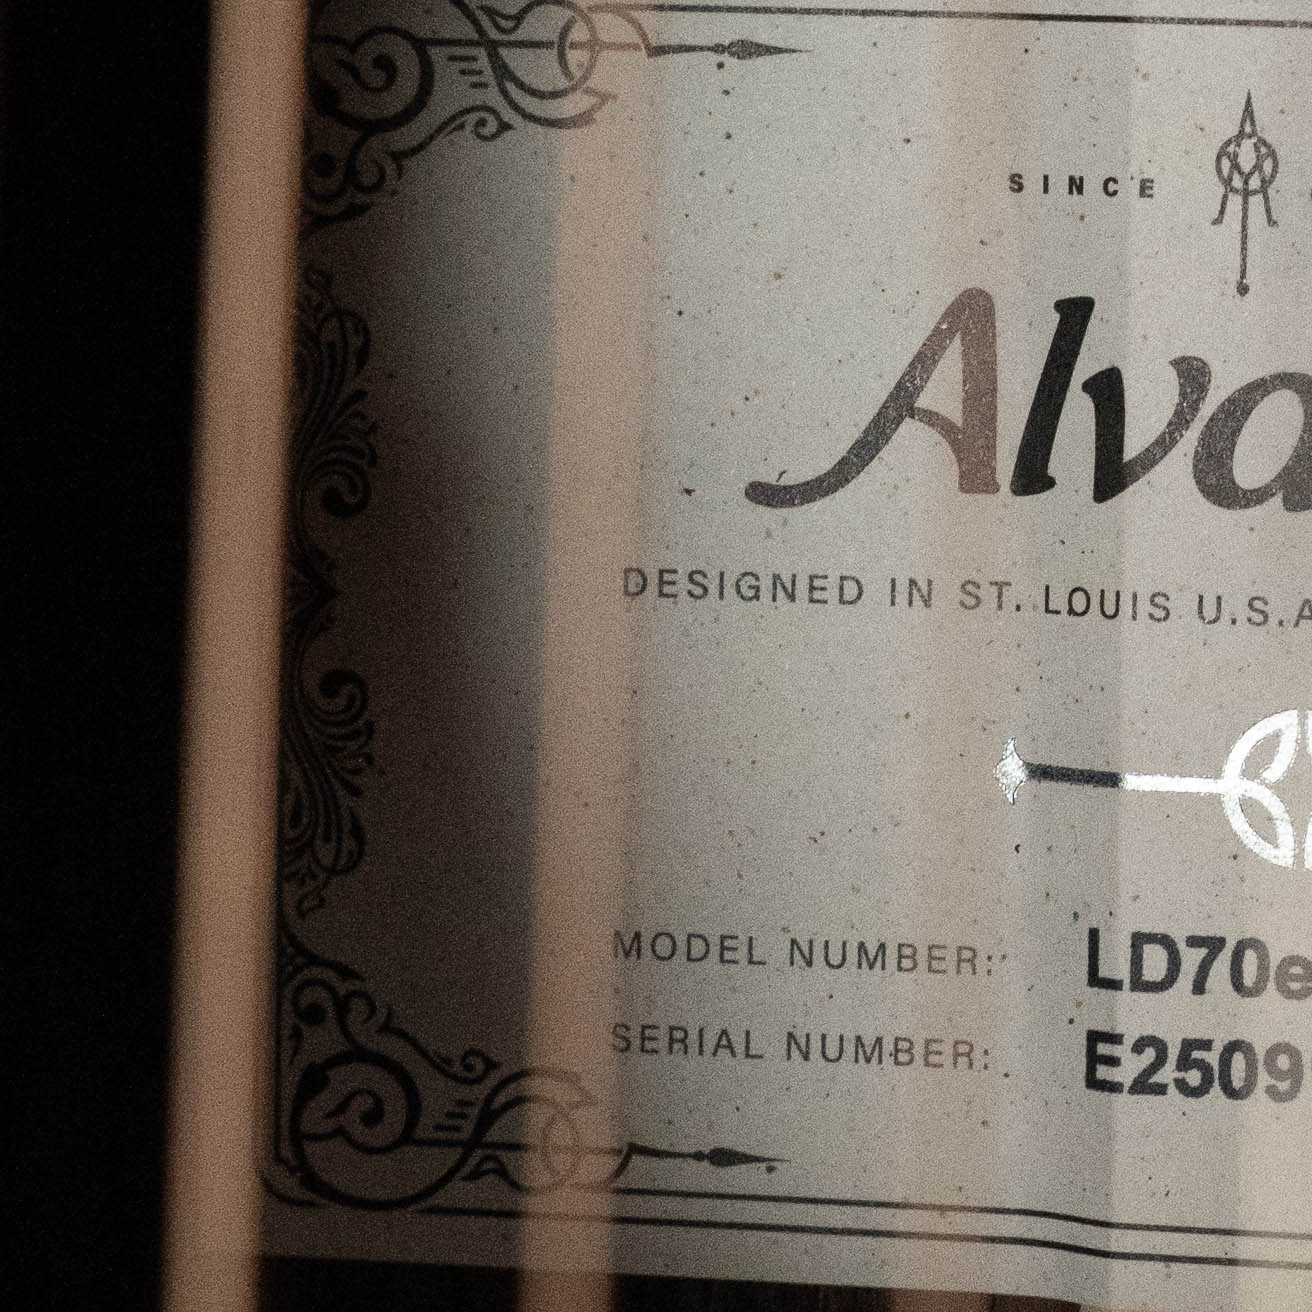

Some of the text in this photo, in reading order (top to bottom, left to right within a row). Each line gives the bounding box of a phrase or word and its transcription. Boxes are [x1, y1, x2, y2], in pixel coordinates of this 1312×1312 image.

[1008, 172, 1155, 199] SINCE
[623, 568, 863, 605] DESIGNED
[890, 578, 934, 608] IN
[959, 580, 1022, 614] ST.
[1043, 585, 1170, 622] LOUIS
[613, 929, 767, 966] MODEL
[789, 937, 994, 976] NUMBER:
[611, 1023, 763, 1059] SERIAL
[786, 1031, 991, 1071] NUMBER:
